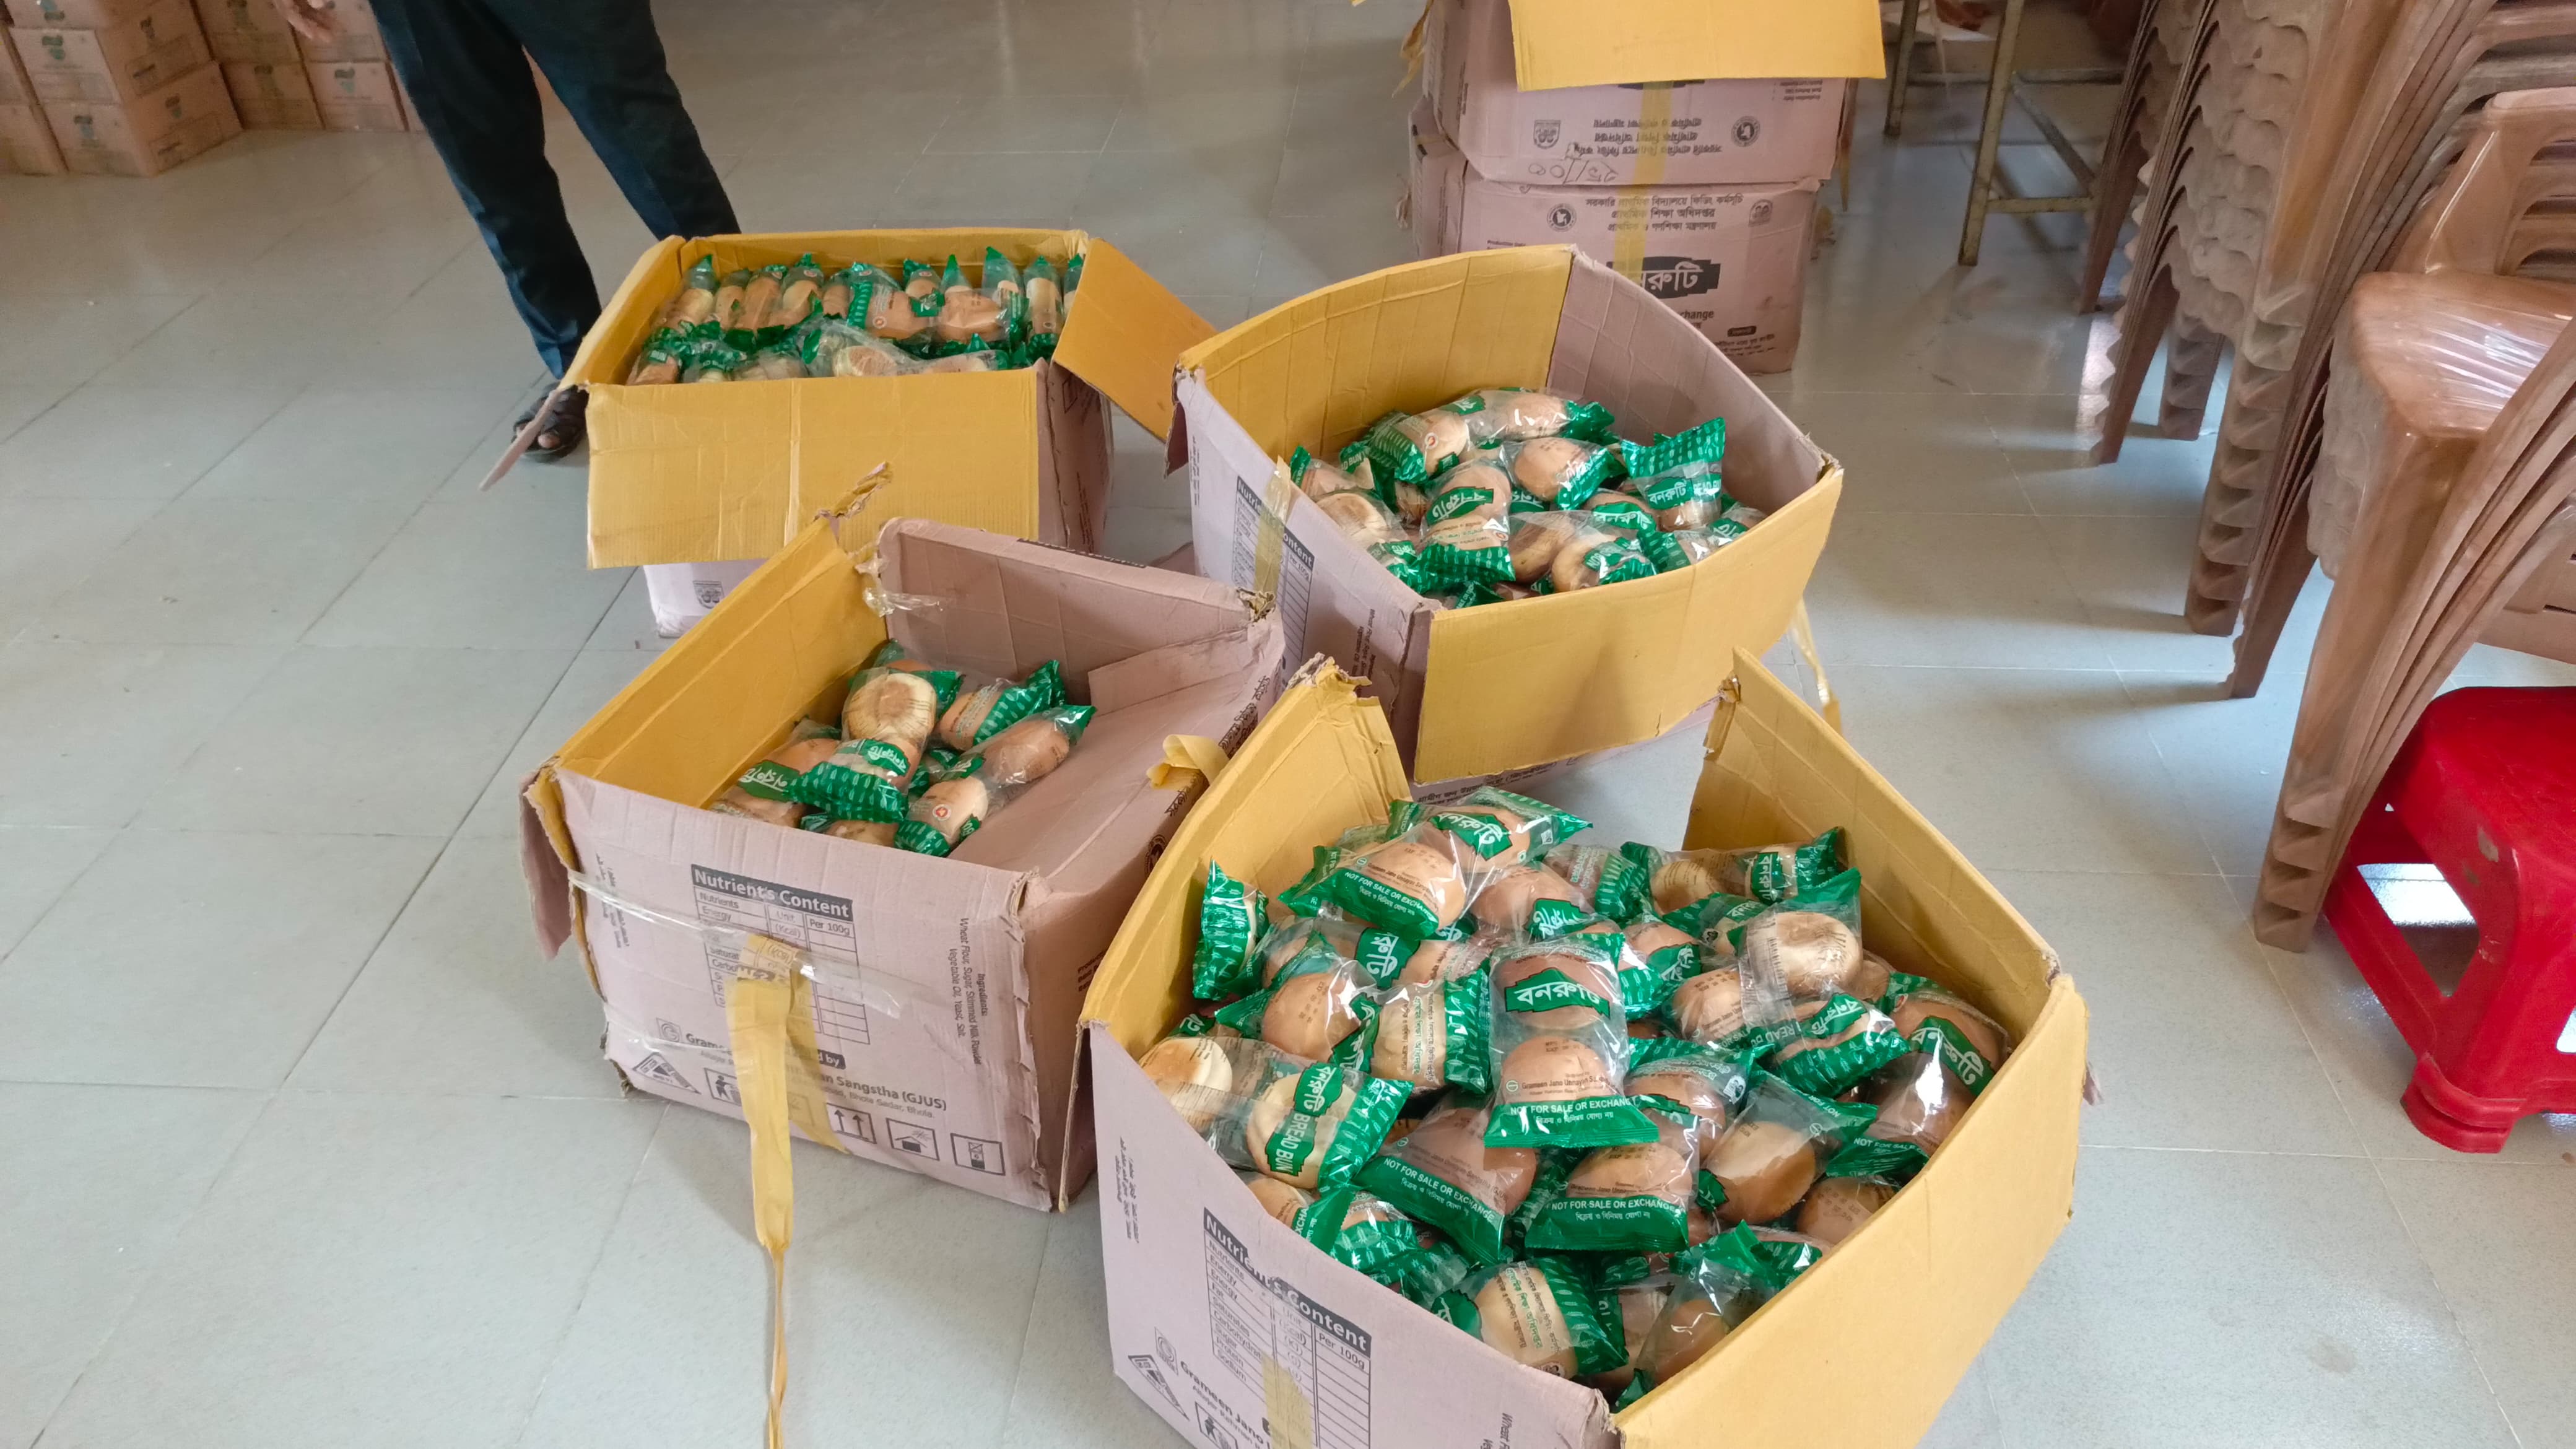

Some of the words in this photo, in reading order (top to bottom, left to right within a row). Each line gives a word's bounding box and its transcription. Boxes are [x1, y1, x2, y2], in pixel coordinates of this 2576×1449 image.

[1679, 310, 1714, 320] change
[1279, 528, 1313, 568] ontent
[1344, 871, 1359, 881] NOT
[1358, 876, 1373, 887] FOR
[1373, 882, 1391, 895] SALE
[1391, 890, 1401, 900] OR
[700, 892, 739, 909] Nutrients
[780, 890, 850, 918] Content
[777, 911, 796, 924] Unit
[809, 919, 824, 929] Per
[828, 923, 850, 936] 100g
[960, 918, 969, 944] Wheat
[948, 948, 960, 985] Vegetable
[1367, 931, 1399, 979] রুটি
[825, 1053, 840, 1067] by
[837, 1076, 899, 1099] Sangstha
[902, 1090, 947, 1111] (GJUS)
[1303, 1066, 1337, 1112] বনরুটি
[1510, 1106, 1528, 1115] NOT
[1531, 1105, 1551, 1114] FOR
[1552, 1104, 1573, 1113] SALE
[1575, 1102, 1588, 1111] OR
[1823, 1105, 1841, 1117] NOT
[1280, 1113, 1311, 1149] BREAD
[1853, 1138, 1873, 1147] NOT
[1275, 1149, 1294, 1173] BUN
[1383, 1157, 1401, 1170] NOT
[1401, 1165, 1418, 1179] FOR
[1417, 1173, 1440, 1190] SALE
[1440, 1185, 1453, 1196] OR
[1454, 1191, 1495, 1223] EXCHANGE
[1552, 1202, 1568, 1211] NOT
[1570, 1201, 1588, 1209] FOR
[1588, 1200, 1611, 1208] SALE
[1614, 1200, 1626, 1208] OR
[1210, 1254, 1237, 1287] Energy
[1211, 1269, 1238, 1300] Energy
[1212, 1282, 1224, 1298] Fat
[1214, 1310, 1263, 1359] Carbohydrat
[1287, 1289, 1367, 1352] Content
[1320, 1333, 1336, 1349] Per
[1339, 1346, 1365, 1370] 100g
[1180, 1361, 1232, 1416] Grameen
[1235, 1413, 1264, 1445] Jano
[1500, 1412, 1513, 1442] Wheat
